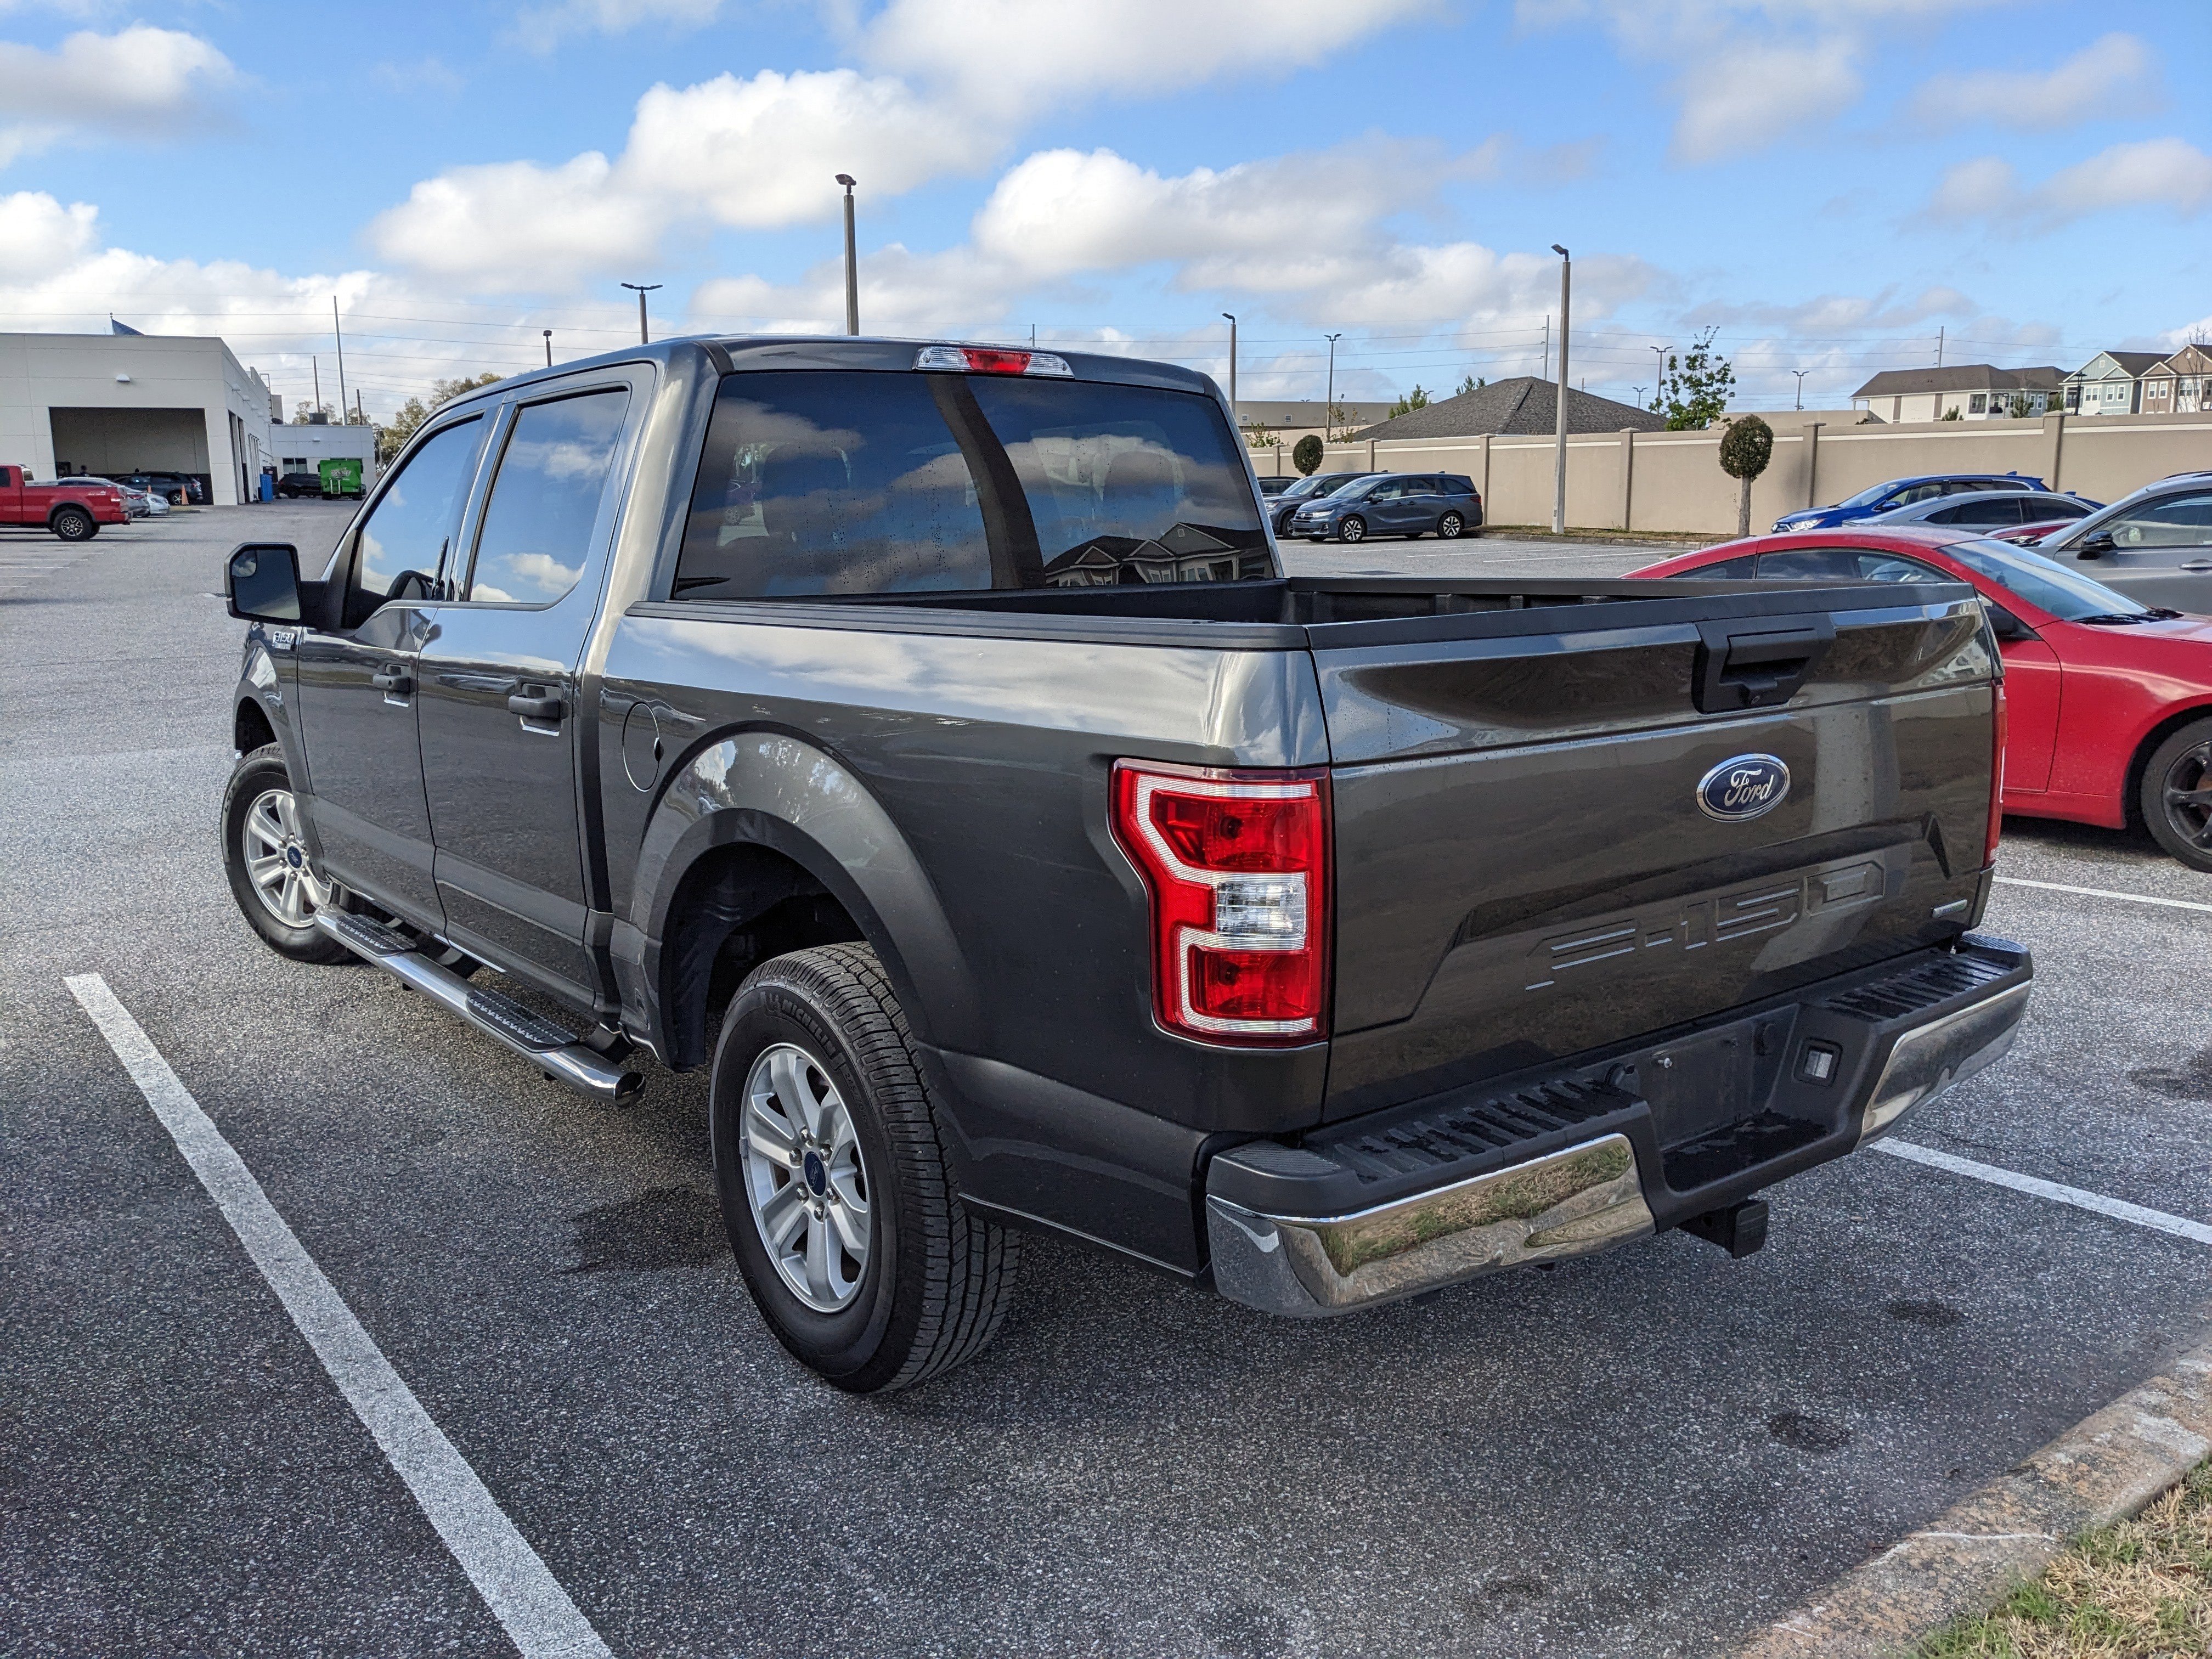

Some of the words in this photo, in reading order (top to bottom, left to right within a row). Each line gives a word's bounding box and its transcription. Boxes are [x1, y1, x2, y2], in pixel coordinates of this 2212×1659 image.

[1724, 768, 1775, 807] Ford
[1525, 860, 1886, 991] F-150
[781, 998, 837, 1057] MICHELIN
